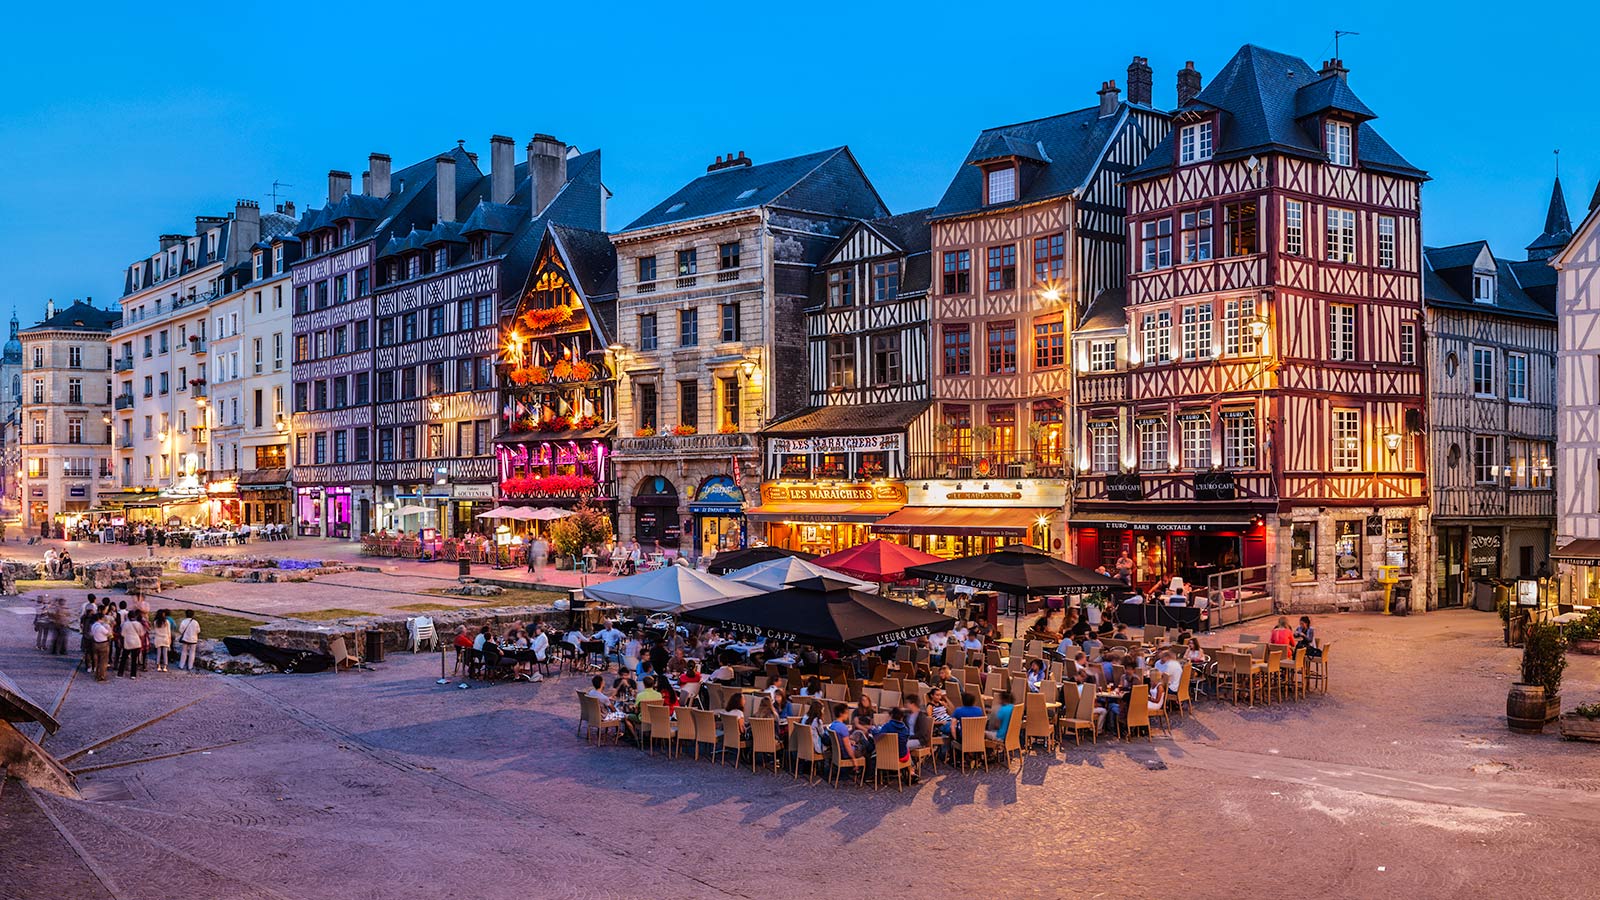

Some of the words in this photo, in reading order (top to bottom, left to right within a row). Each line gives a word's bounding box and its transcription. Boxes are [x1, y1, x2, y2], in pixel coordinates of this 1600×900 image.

[792, 440, 810, 450] LES
[790, 489, 808, 499] LES
[934, 574, 967, 586] L'EURO
[971, 579, 994, 590] CAFE
[1058, 586, 1087, 595] L'EURO
[721, 620, 762, 636] L'EURO
[766, 629, 797, 642] CAFE
[876, 630, 908, 645] L'EURO
[911, 626, 932, 637] CAFE
